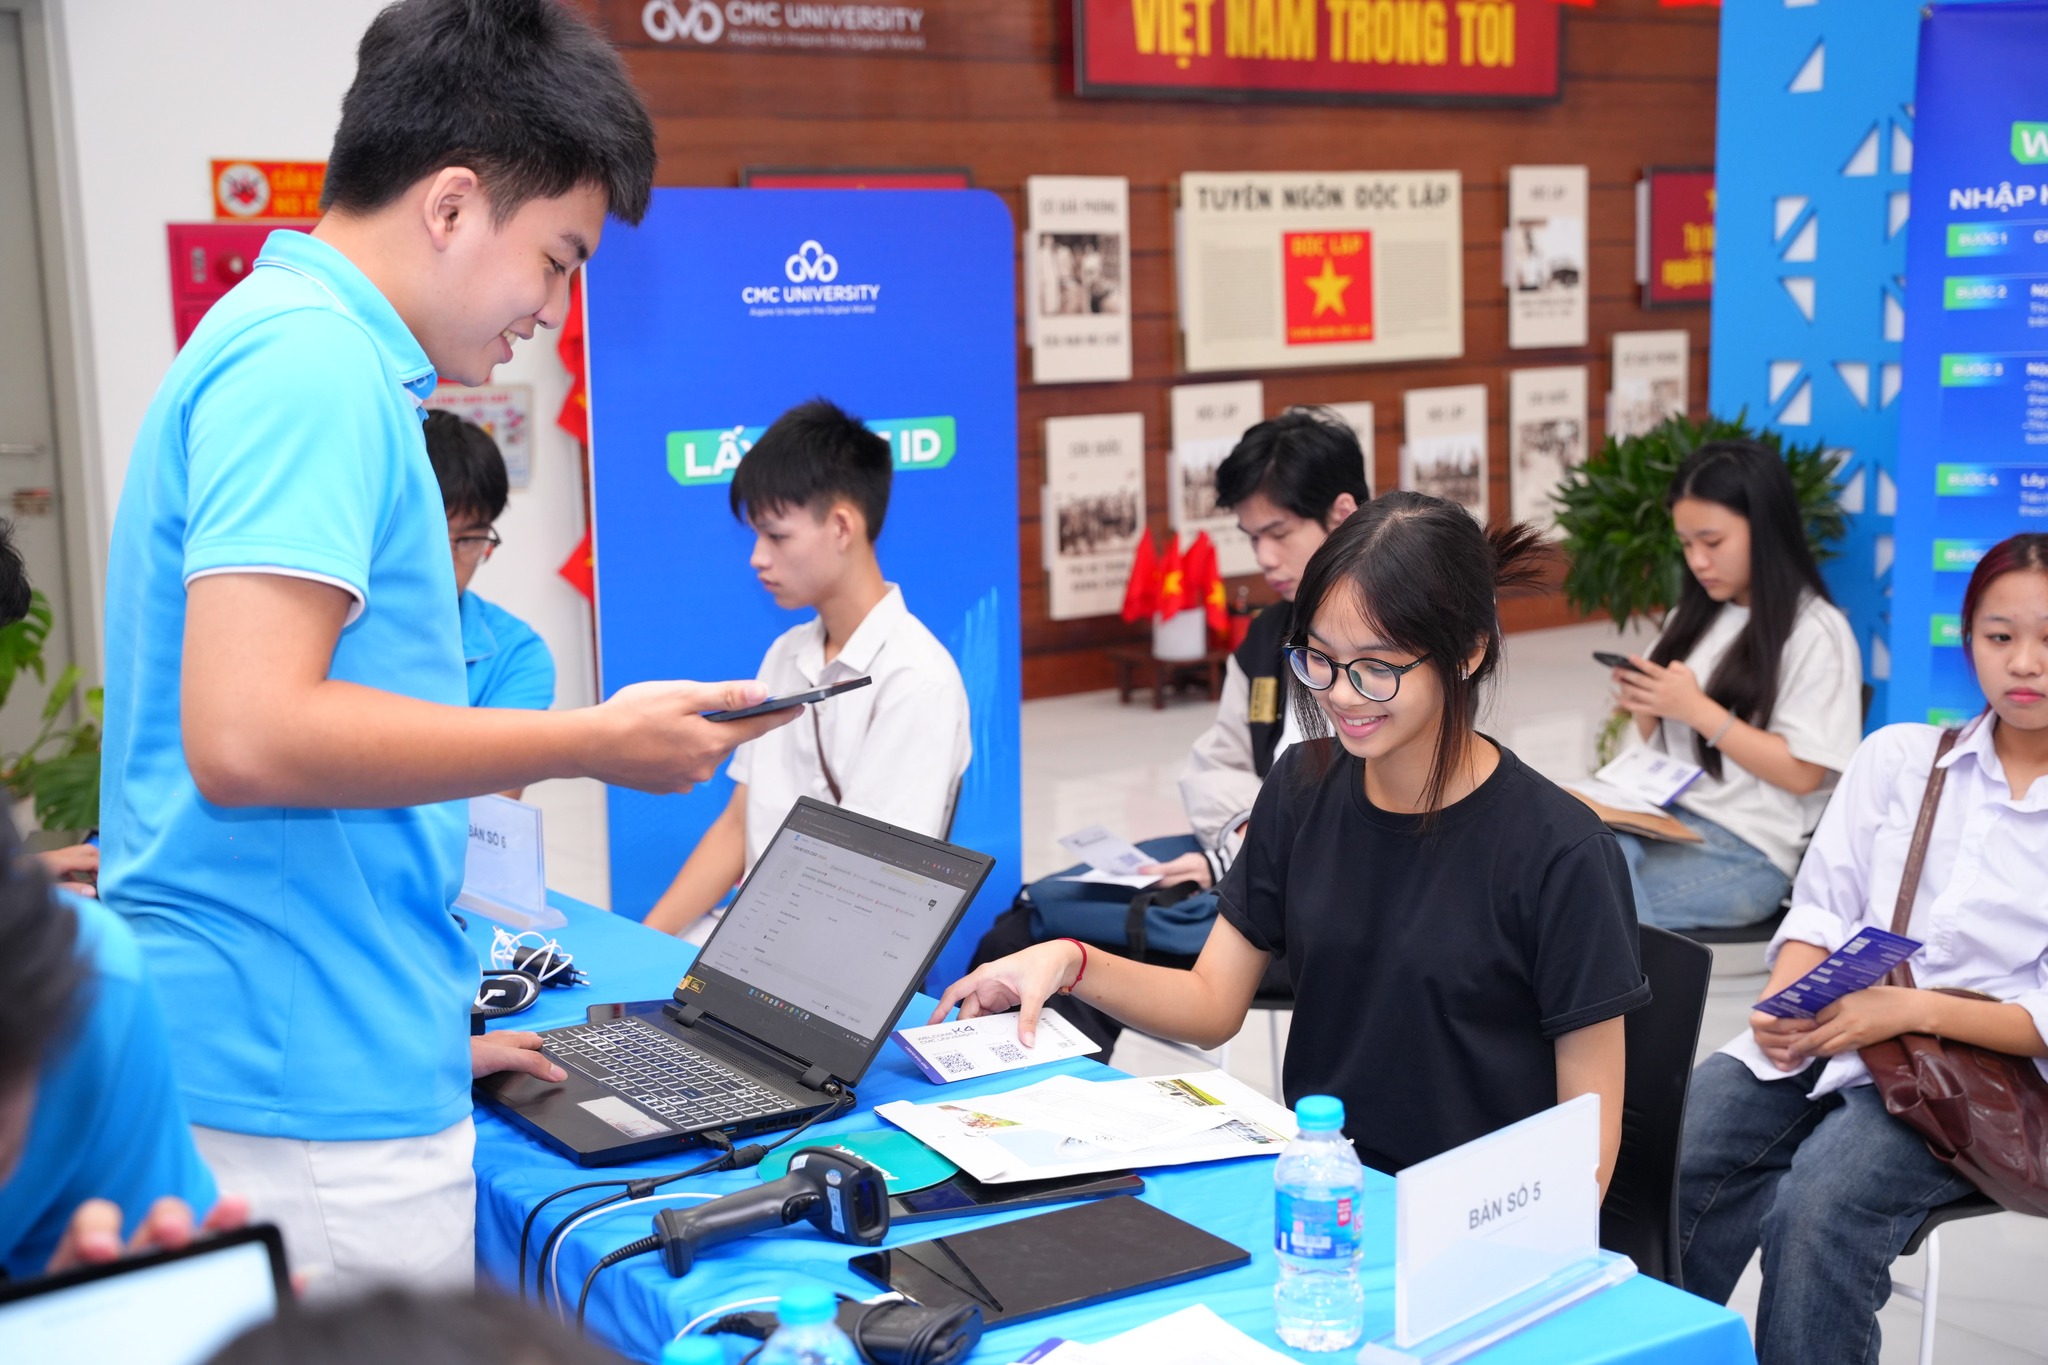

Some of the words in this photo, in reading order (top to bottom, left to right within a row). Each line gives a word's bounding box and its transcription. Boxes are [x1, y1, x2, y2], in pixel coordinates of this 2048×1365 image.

[724, 1, 781, 27] CMC
[785, 3, 924, 32] UNIVERSITY
[1225, 0, 1317, 61] NAM
[1325, 0, 1449, 66] TRONG
[1949, 181, 2036, 213] NHẬP
[741, 286, 780, 304] CMC
[783, 284, 880, 303] UNIVERSITY
[684, 425, 753, 477] LẤ
[901, 429, 942, 463] ID
[501, 836, 507, 849] 6
[951, 1025, 975, 1034] K4
[1533, 1180, 1541, 1201] 5
